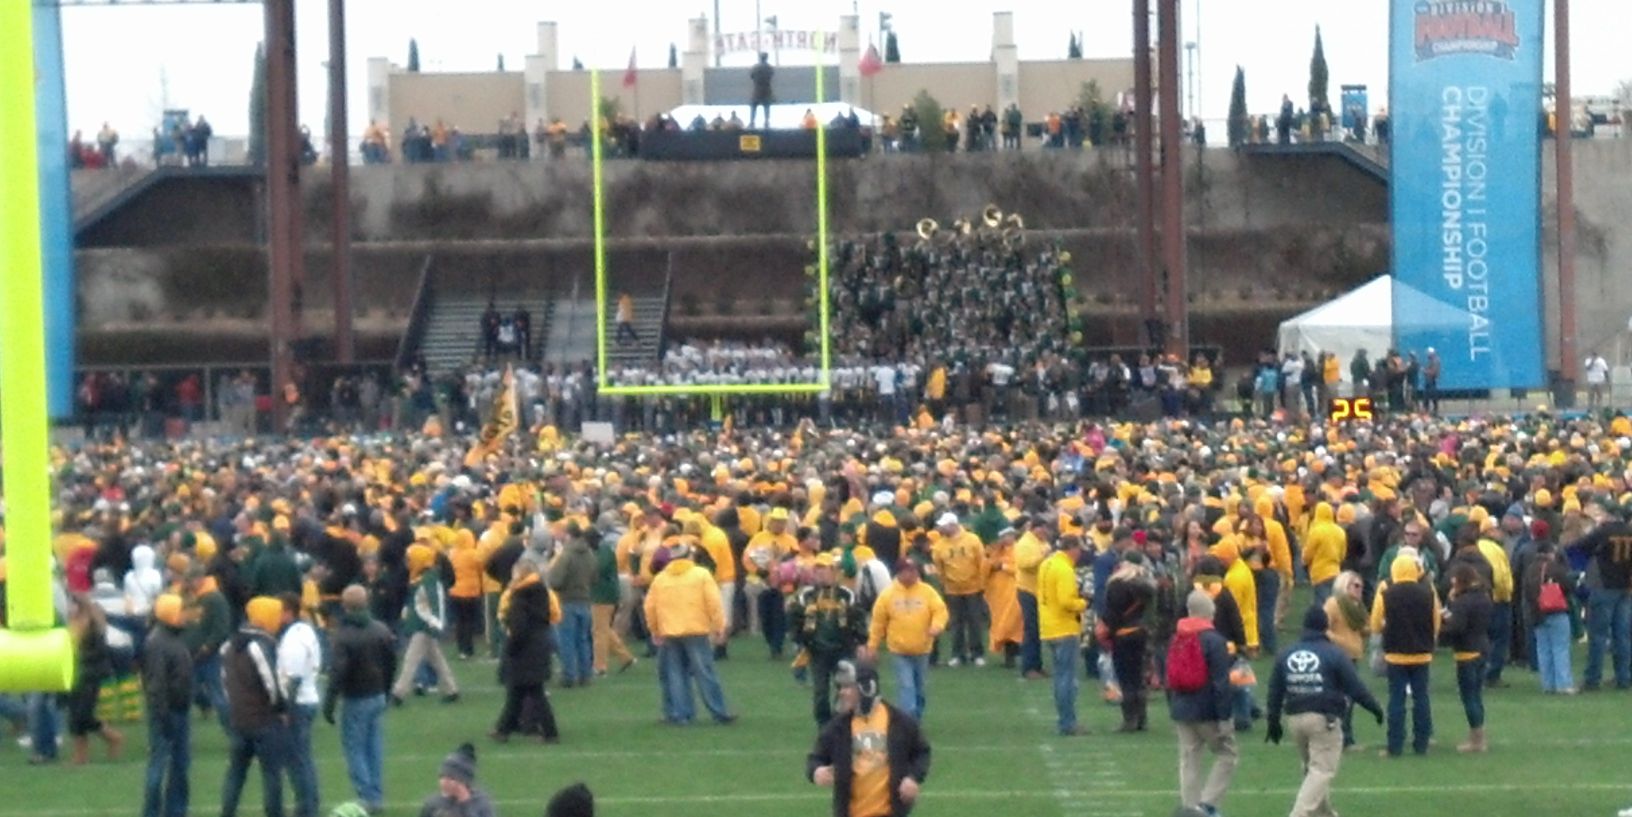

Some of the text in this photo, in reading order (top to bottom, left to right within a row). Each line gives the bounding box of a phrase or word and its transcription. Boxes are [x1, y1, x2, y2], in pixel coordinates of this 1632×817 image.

[1442, 86, 1462, 289] CHAMPIONSHIP
[1466, 86, 1487, 199] DIVISION
[1466, 223, 1490, 361] FOOTBALL
[1332, 398, 1372, 422] 25
